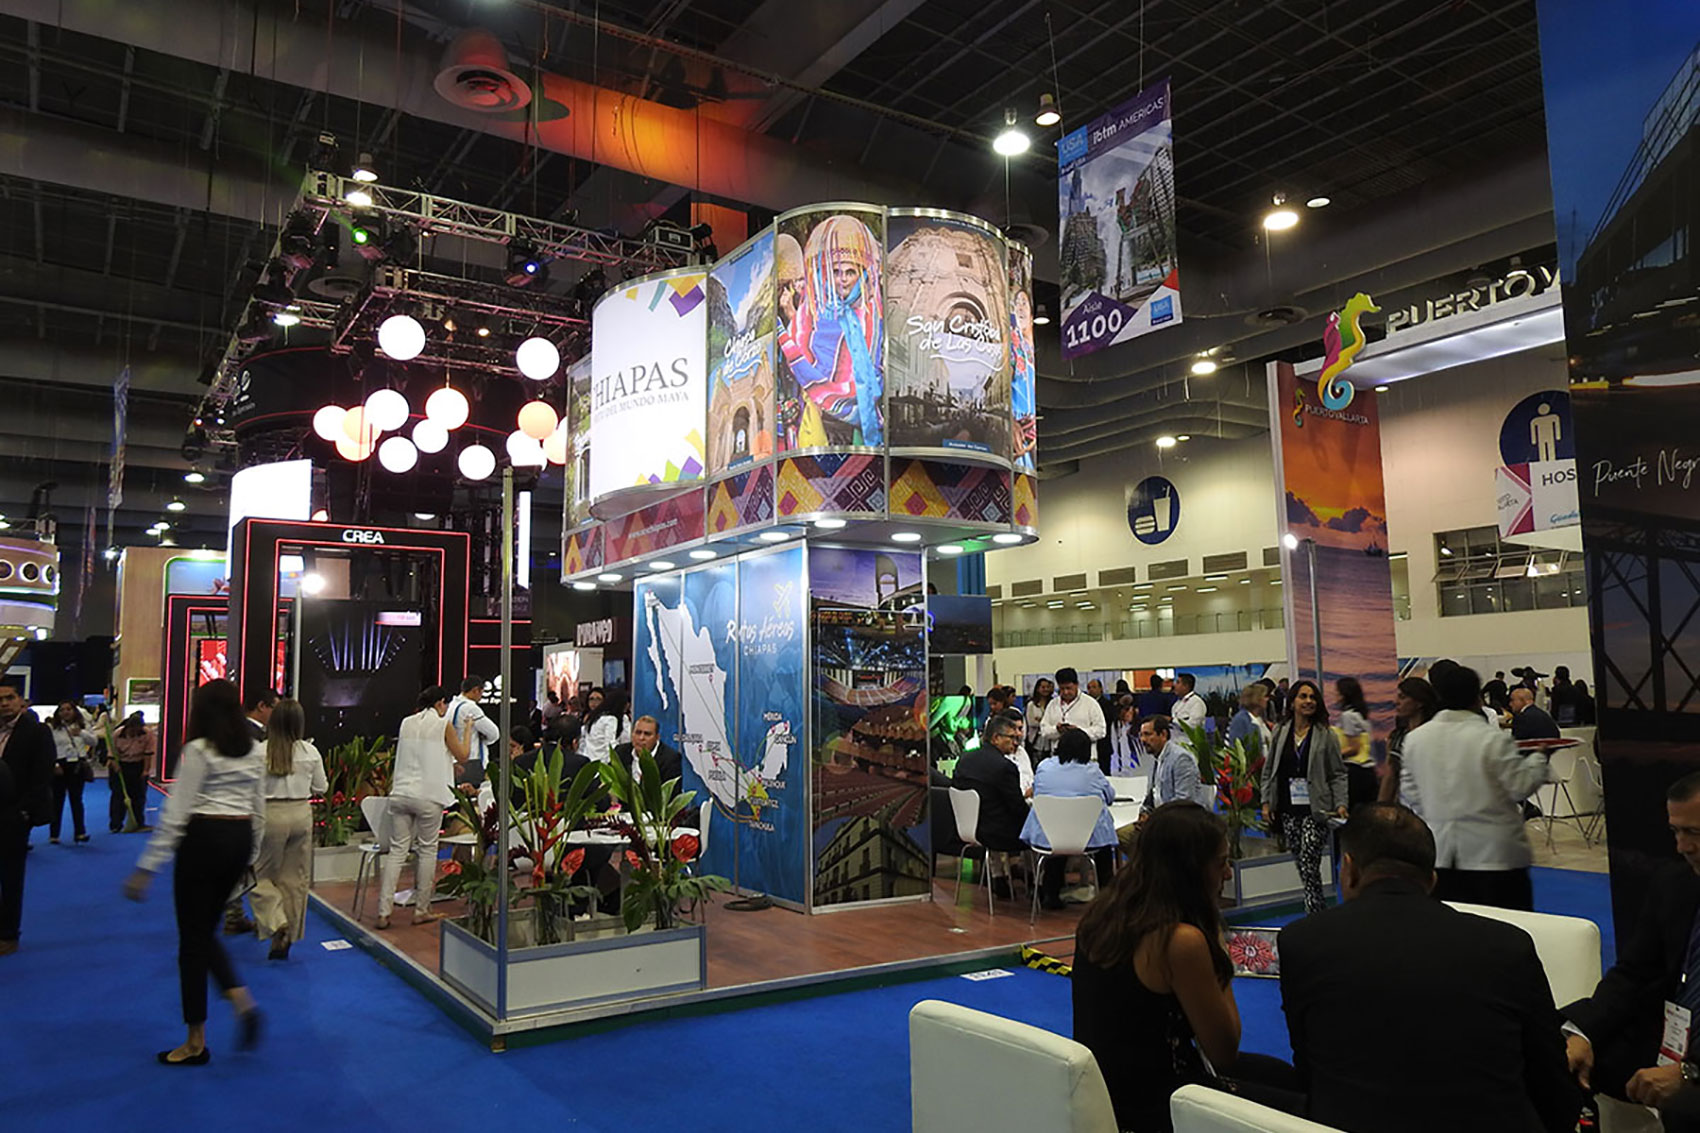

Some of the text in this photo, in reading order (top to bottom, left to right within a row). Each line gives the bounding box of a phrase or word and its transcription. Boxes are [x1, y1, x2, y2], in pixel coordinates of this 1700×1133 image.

[1118, 97, 1165, 131] AMERICAS
[907, 315, 945, 335] San
[1066, 308, 1122, 349] 1100
[919, 332, 942, 351] de
[593, 357, 689, 411] HIAPAS
[1592, 456, 1648, 496] Puente
[342, 529, 386, 545] CREA
[725, 619, 757, 644] Rtas
